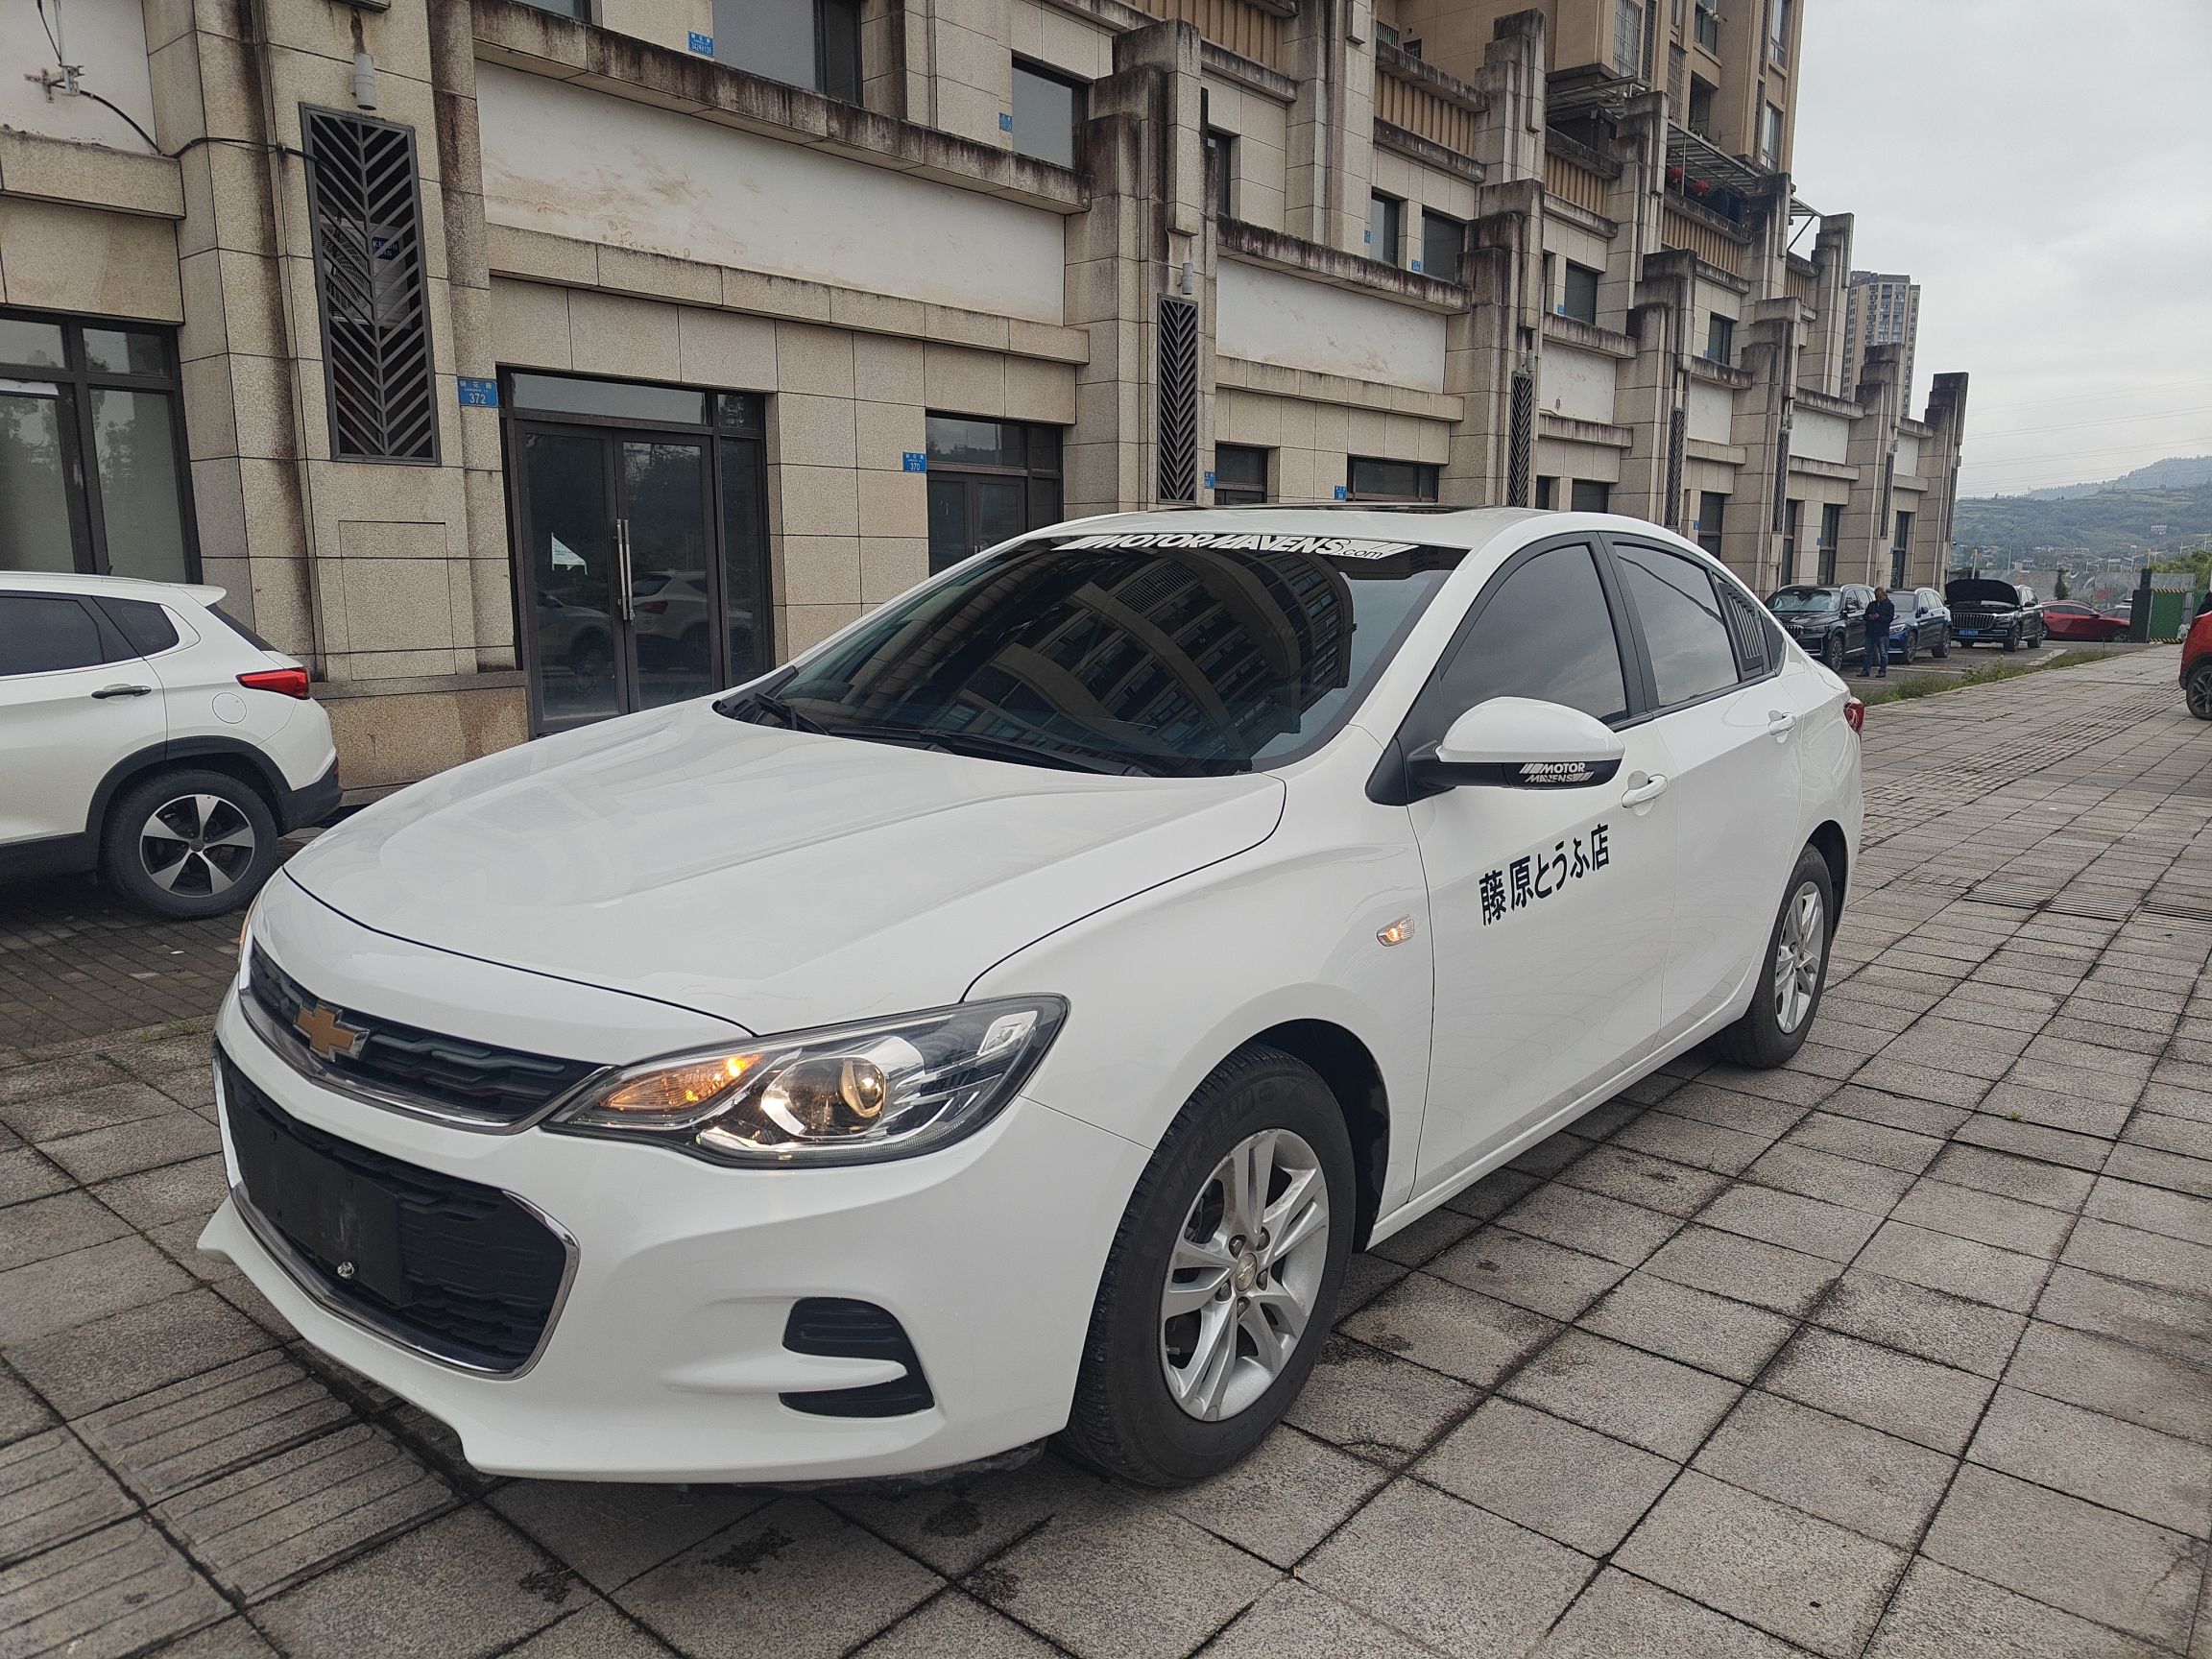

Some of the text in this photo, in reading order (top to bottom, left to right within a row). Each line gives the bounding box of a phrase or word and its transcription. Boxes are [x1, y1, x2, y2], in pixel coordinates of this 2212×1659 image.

[469, 393, 486, 403] 372
[910, 462, 921, 470] 370
[1538, 762, 1586, 774] MOTOR
[1479, 823, 1610, 926] 藤原とうふ店
